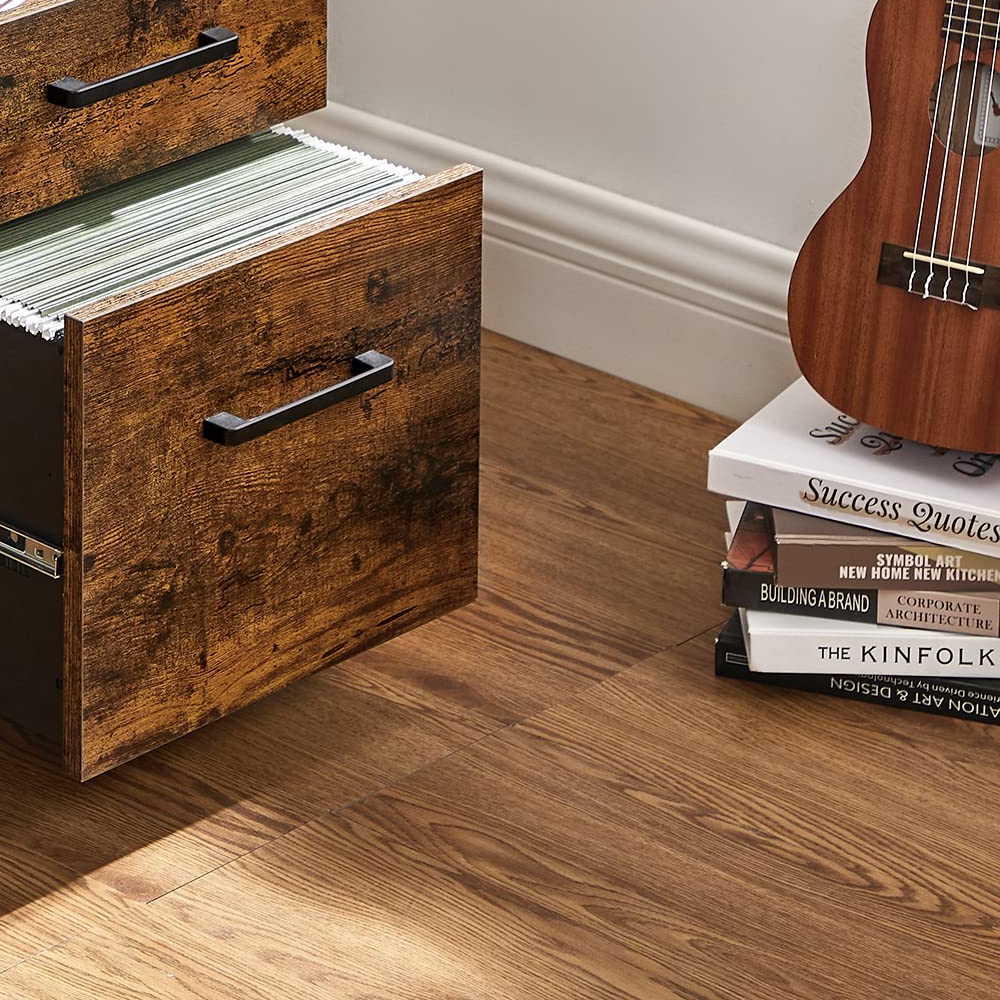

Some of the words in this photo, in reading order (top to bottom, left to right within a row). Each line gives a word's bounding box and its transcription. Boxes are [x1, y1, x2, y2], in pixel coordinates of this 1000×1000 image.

[803, 477, 902, 520] Success
[907, 501, 1000, 544] Quotes
[876, 553, 932, 567] SYMBOL
[936, 555, 963, 568] ART
[839, 566, 867, 579] NEW
[871, 567, 910, 580] HOME
[914, 568, 945, 581] NEW
[946, 568, 1000, 582] KITCHEN
[761, 583, 817, 606] BUILDING
[818, 590, 827, 607] A
[828, 591, 870, 613] BRAND
[897, 595, 982, 615] CORPORATE
[885, 609, 993, 630] ARCHITECTURE
[818, 646, 850, 660] THE
[861, 645, 995, 666] KINFOLK
[830, 677, 891, 699] DESIGN
[916, 680, 929, 691] by
[931, 683, 965, 698] Driven
[896, 689, 909, 702] &
[912, 692, 944, 708] ART
